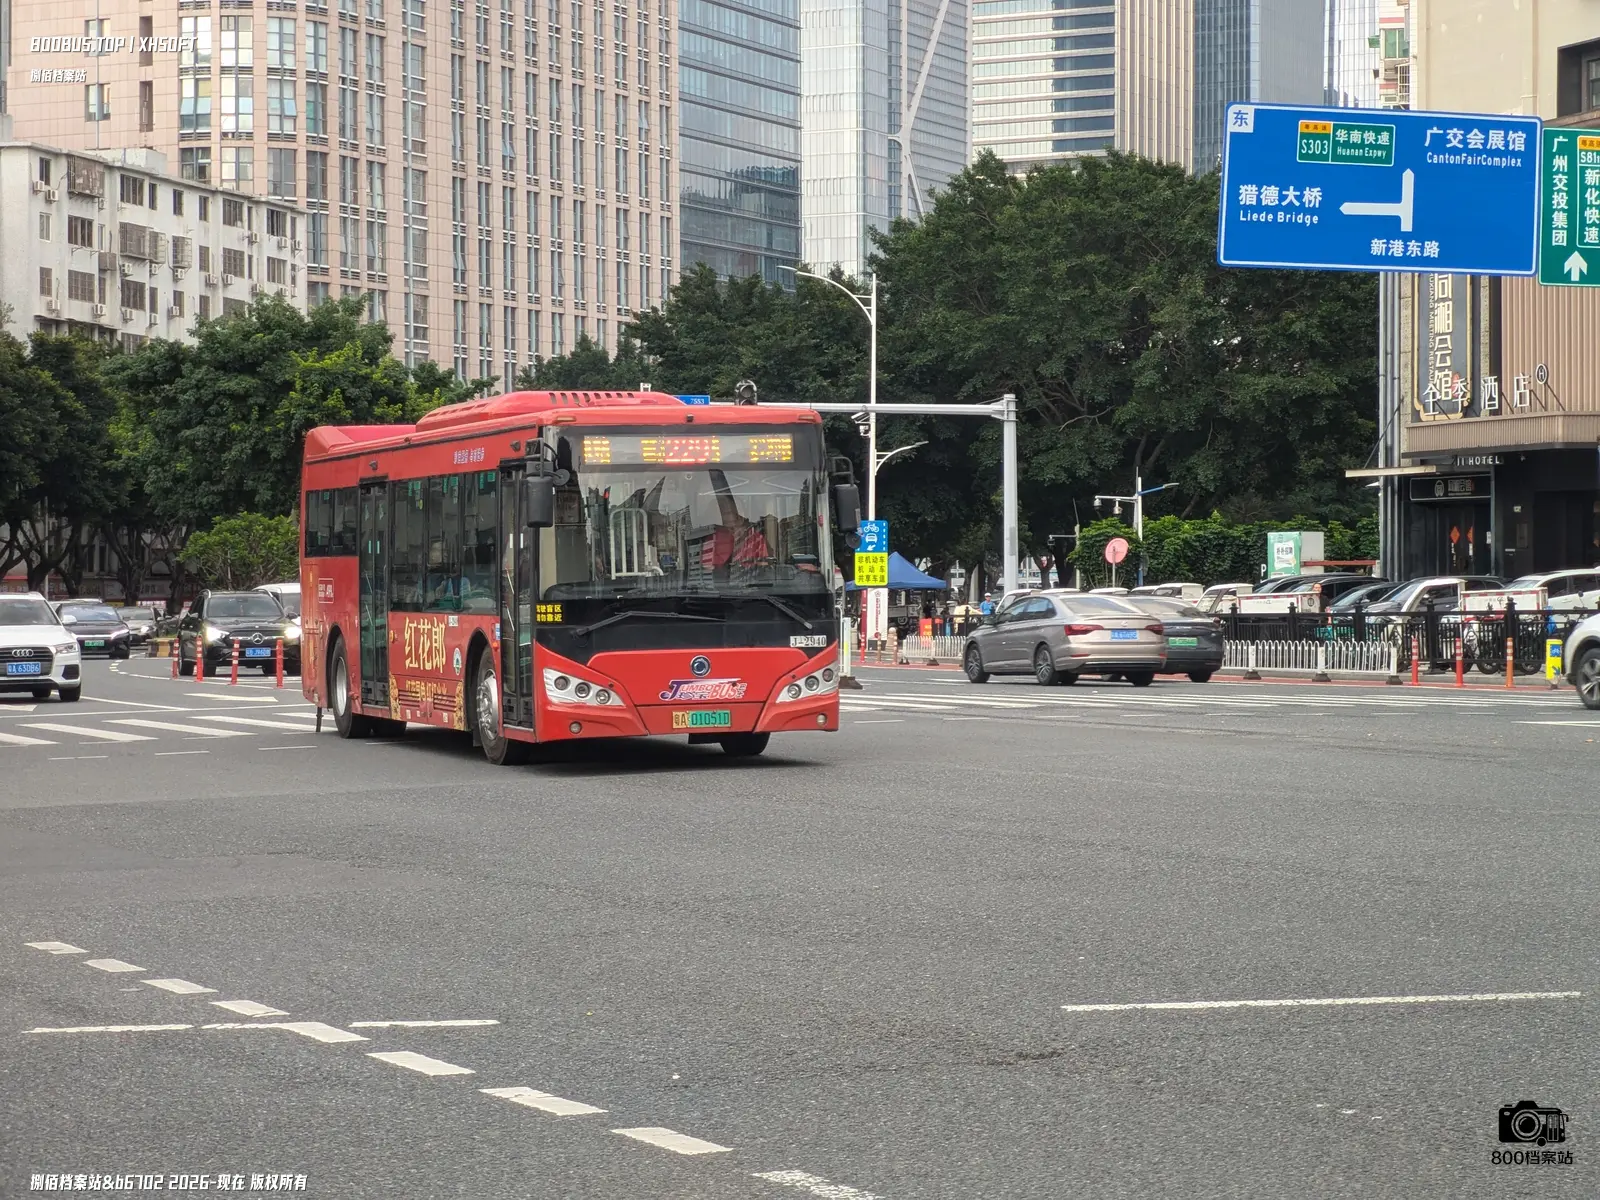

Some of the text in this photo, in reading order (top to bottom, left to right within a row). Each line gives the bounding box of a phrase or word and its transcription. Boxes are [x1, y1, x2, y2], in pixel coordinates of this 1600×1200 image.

[1232, 110, 1249, 127] 东
[1335, 129, 1390, 145] 华南快速
[1424, 127, 1526, 151] 广交会展馆
[1301, 140, 1329, 154] S303
[1337, 146, 1387, 159] Huanan Expwy
[1427, 152, 1522, 168] CantonFairComplex
[1238, 184, 1322, 208] 猎德大桥
[1551, 136, 1568, 247] 广州交投集团
[1240, 210, 1319, 227] Liede Bridge
[1370, 238, 1440, 258] 新港东路
[1423, 373, 1531, 416] 全季酒店
[1468, 455, 1500, 465] HOTEL
[1260, 563, 1267, 577] P
[404, 616, 446, 673] 红花郎
